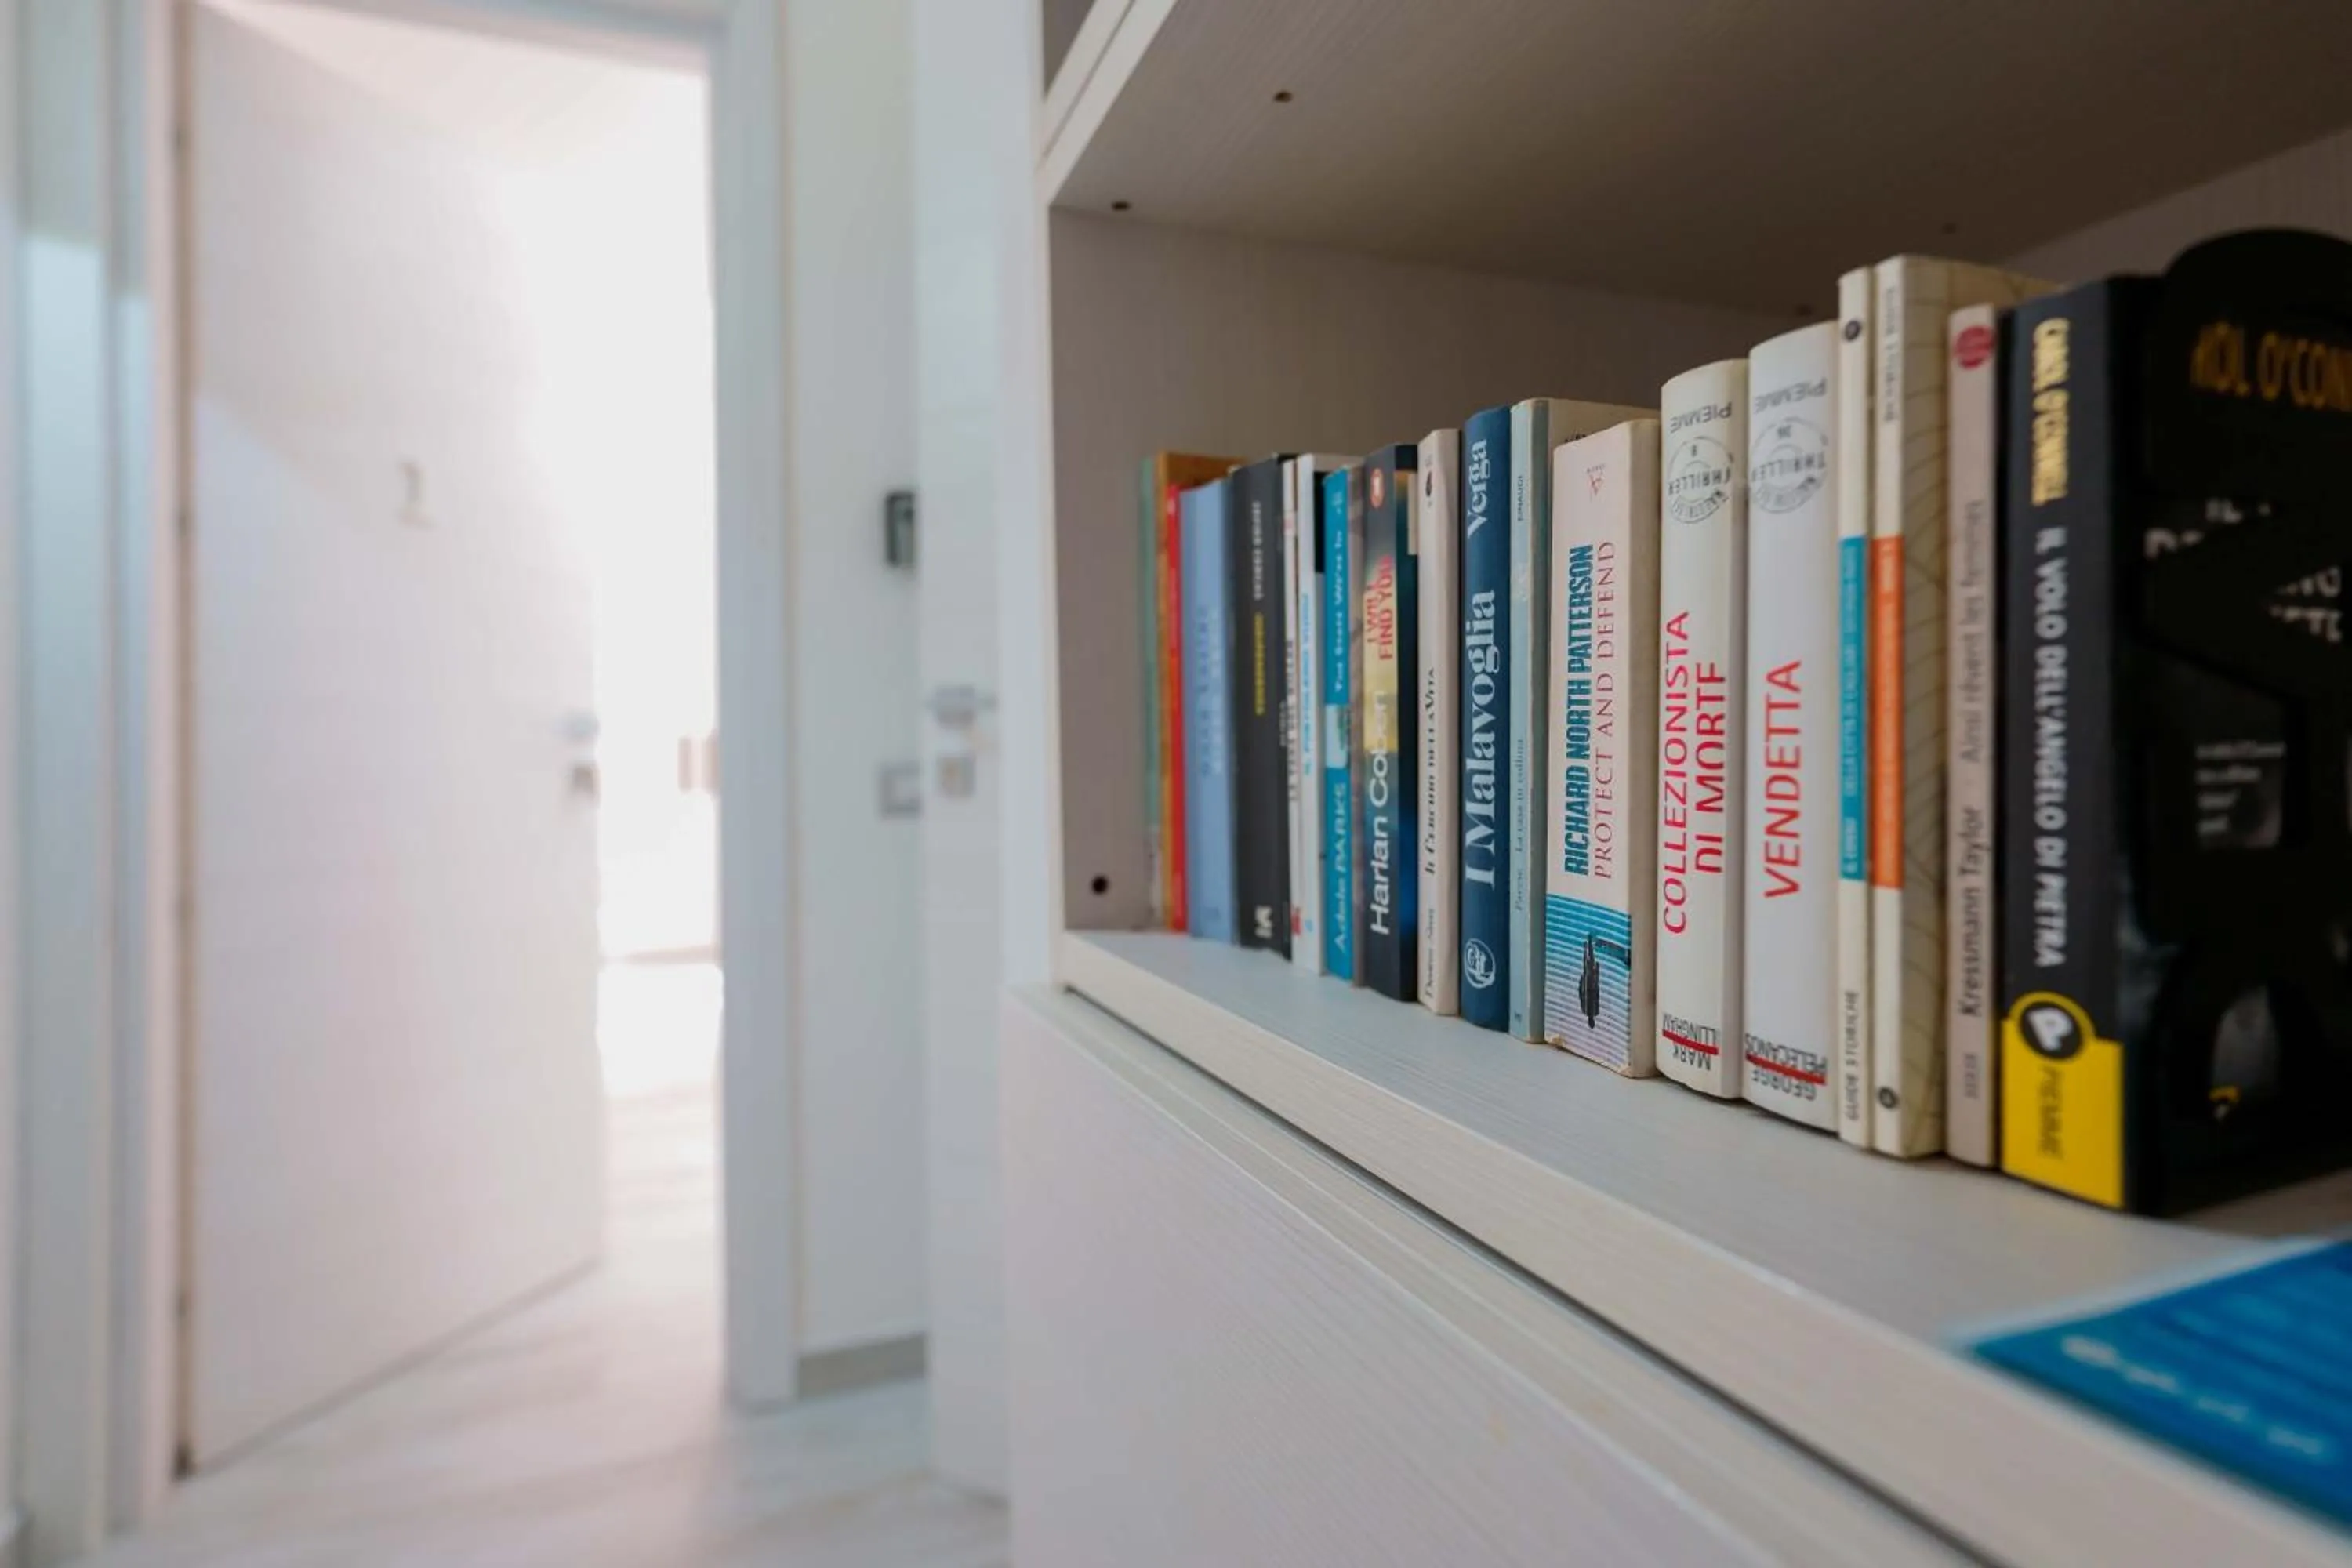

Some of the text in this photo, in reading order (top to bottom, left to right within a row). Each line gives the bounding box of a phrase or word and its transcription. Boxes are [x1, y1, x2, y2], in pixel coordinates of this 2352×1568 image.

[1668, 467, 1731, 495] THRILLER
[1670, 401, 1733, 434] PIEMME
[1466, 438, 1491, 538] Verga
[1377, 555, 1394, 661] FIND YOU
[1465, 590, 1501, 891] I Malavoglia
[1512, 739, 1524, 784] collina
[1564, 544, 1593, 877] RICHARD NORTH PATTERSON
[1594, 541, 1615, 880] PROTECT AND DEFEND
[1663, 611, 1688, 935] COLLEZIONISTA
[1695, 662, 1726, 874] DI MORTE
[2034, 527, 2067, 968] IL VOLO DELL'ANGELO DI PIETRA
[1368, 690, 1391, 935] Harlan Coben
[1763, 659, 1802, 898] VENDETTA
[1957, 805, 1992, 879] Taylor
[1333, 783, 1347, 954] Adele PARKS
[1958, 887, 1983, 1017] Kressmann
[1672, 1044, 1712, 1072] MARK
[1745, 1032, 1828, 1077] PELECANOS
[1751, 1069, 1818, 1102] GEORGE
[1844, 990, 1860, 1121] GUIDE STORICHE
